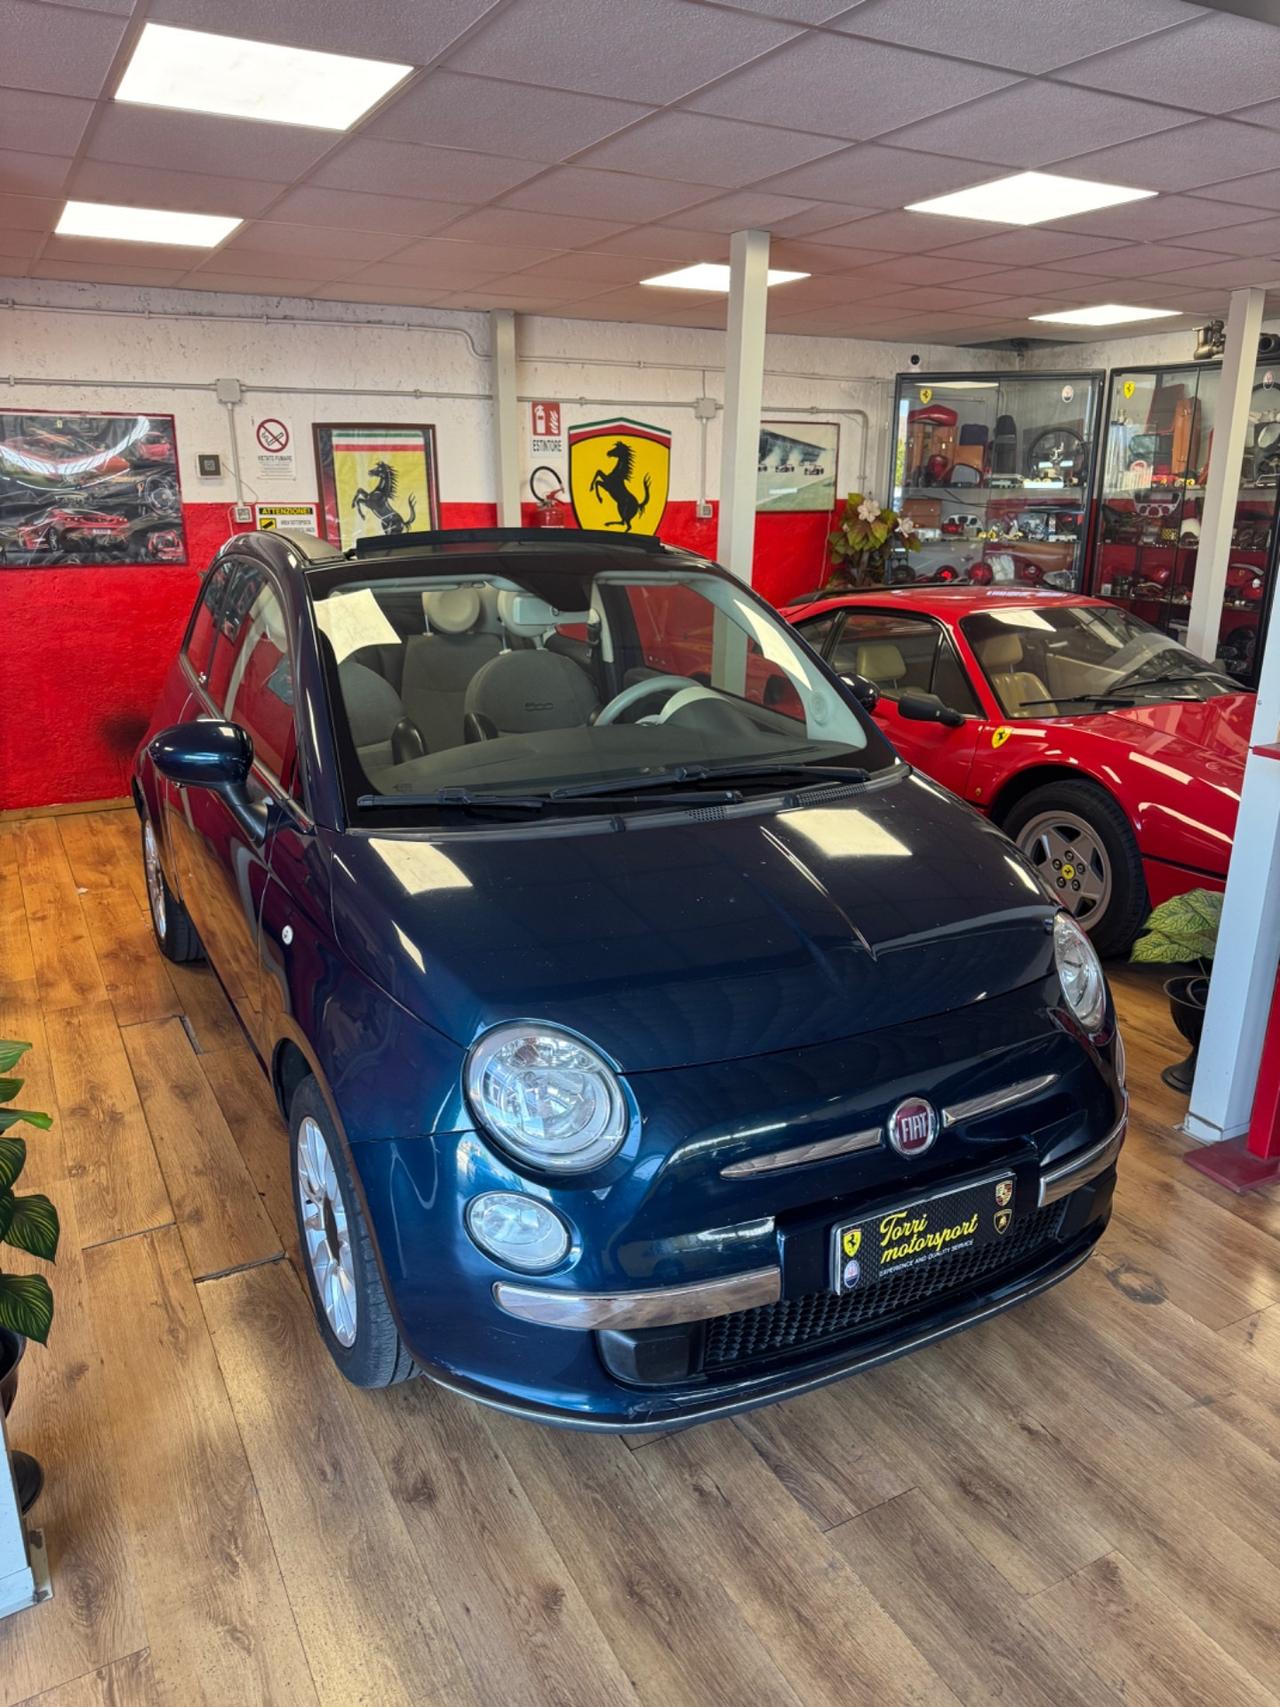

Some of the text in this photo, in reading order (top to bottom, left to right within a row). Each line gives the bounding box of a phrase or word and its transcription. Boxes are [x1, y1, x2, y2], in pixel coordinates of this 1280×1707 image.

[901, 1112, 927, 1143] FIAT
[879, 1211, 929, 1246] Torri
[879, 1213, 979, 1264] motorsport
